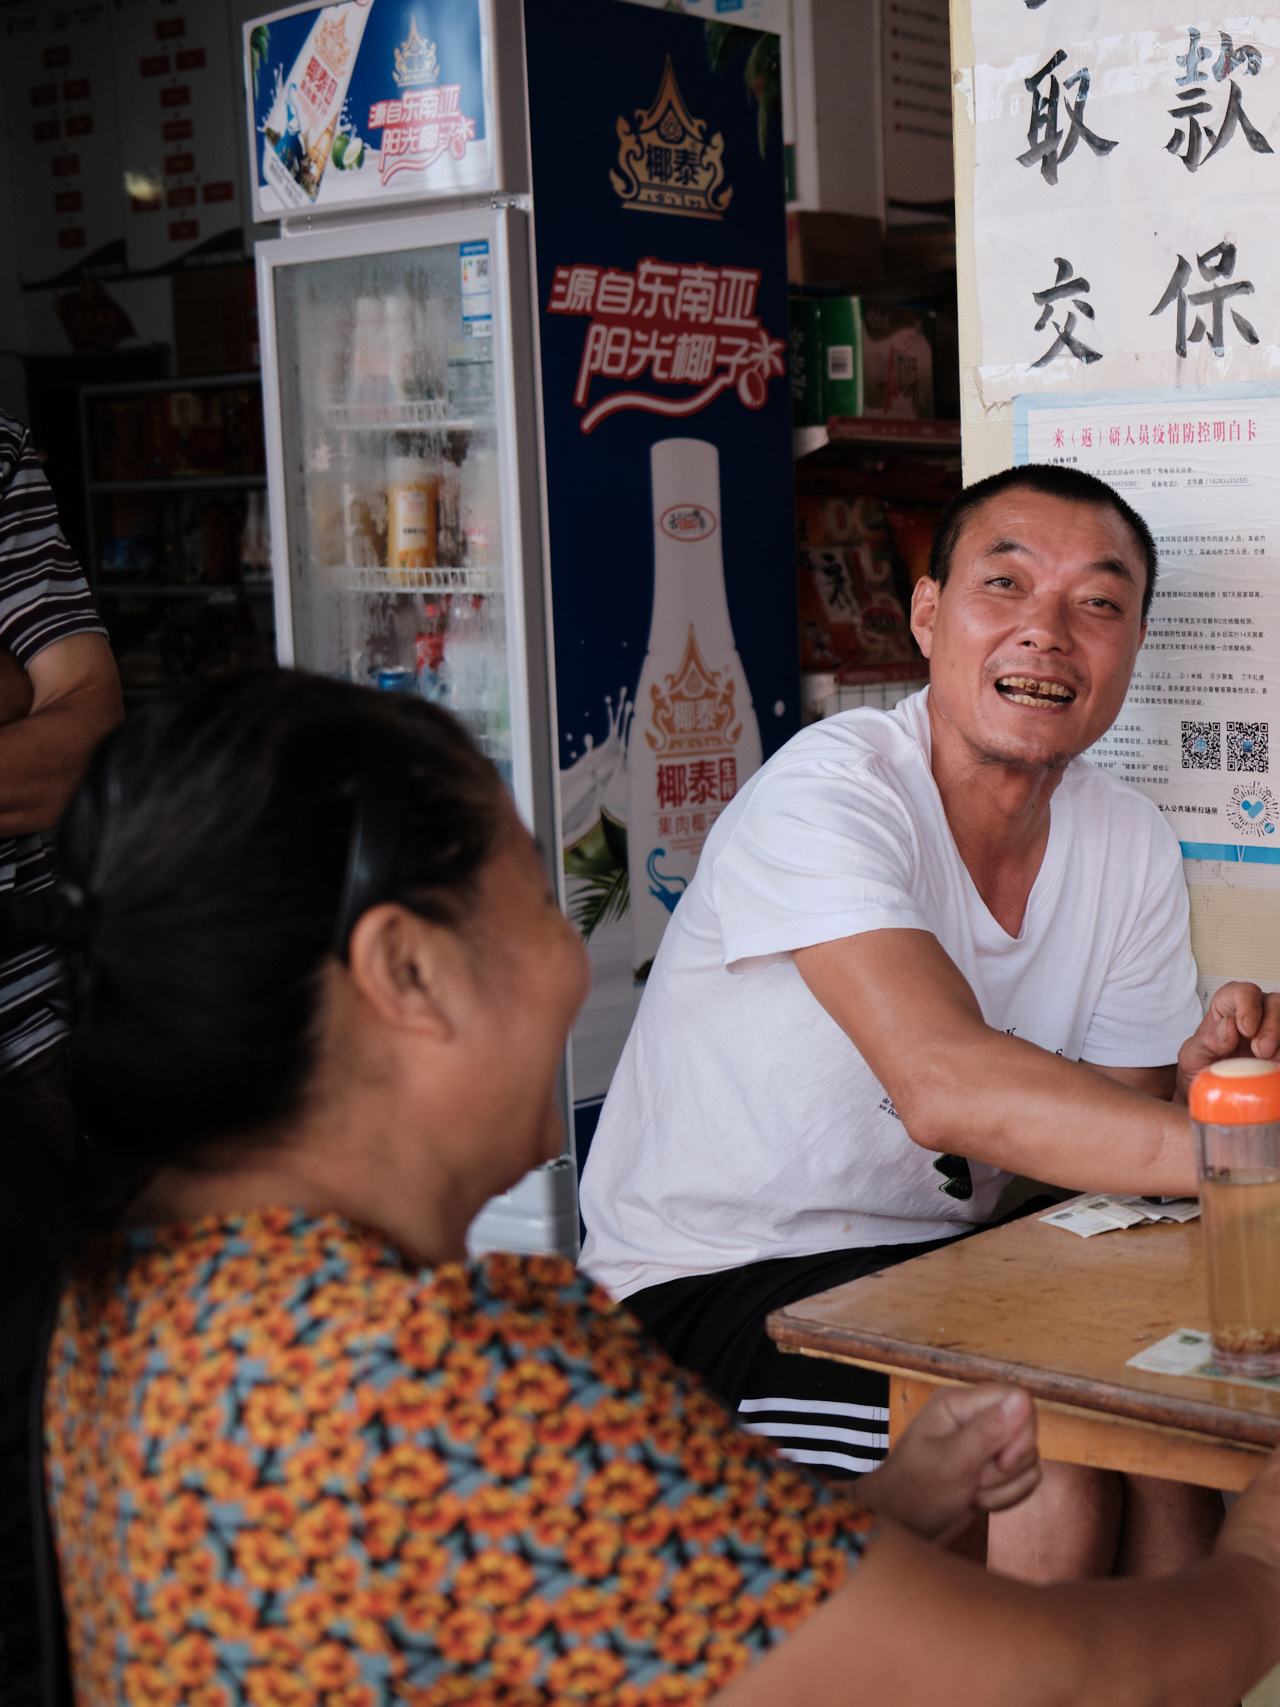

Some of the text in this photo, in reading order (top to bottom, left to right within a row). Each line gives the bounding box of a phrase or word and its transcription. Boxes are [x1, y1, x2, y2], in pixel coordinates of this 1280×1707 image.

[369, 85, 461, 128] 源自东南亚
[1015, 27, 1275, 186] 取款
[380, 119, 460, 170] 阳光椰子
[649, 143, 702, 186] 椰泰
[551, 260, 760, 329] 源自东南亚
[1025, 240, 1260, 372] 交保
[574, 324, 752, 403] 阳光椰子
[1052, 419, 1257, 449] 来（返）研人员疫情防控明白卡
[674, 699, 718, 733] 椰泰
[657, 760, 719, 808] 椰泰
